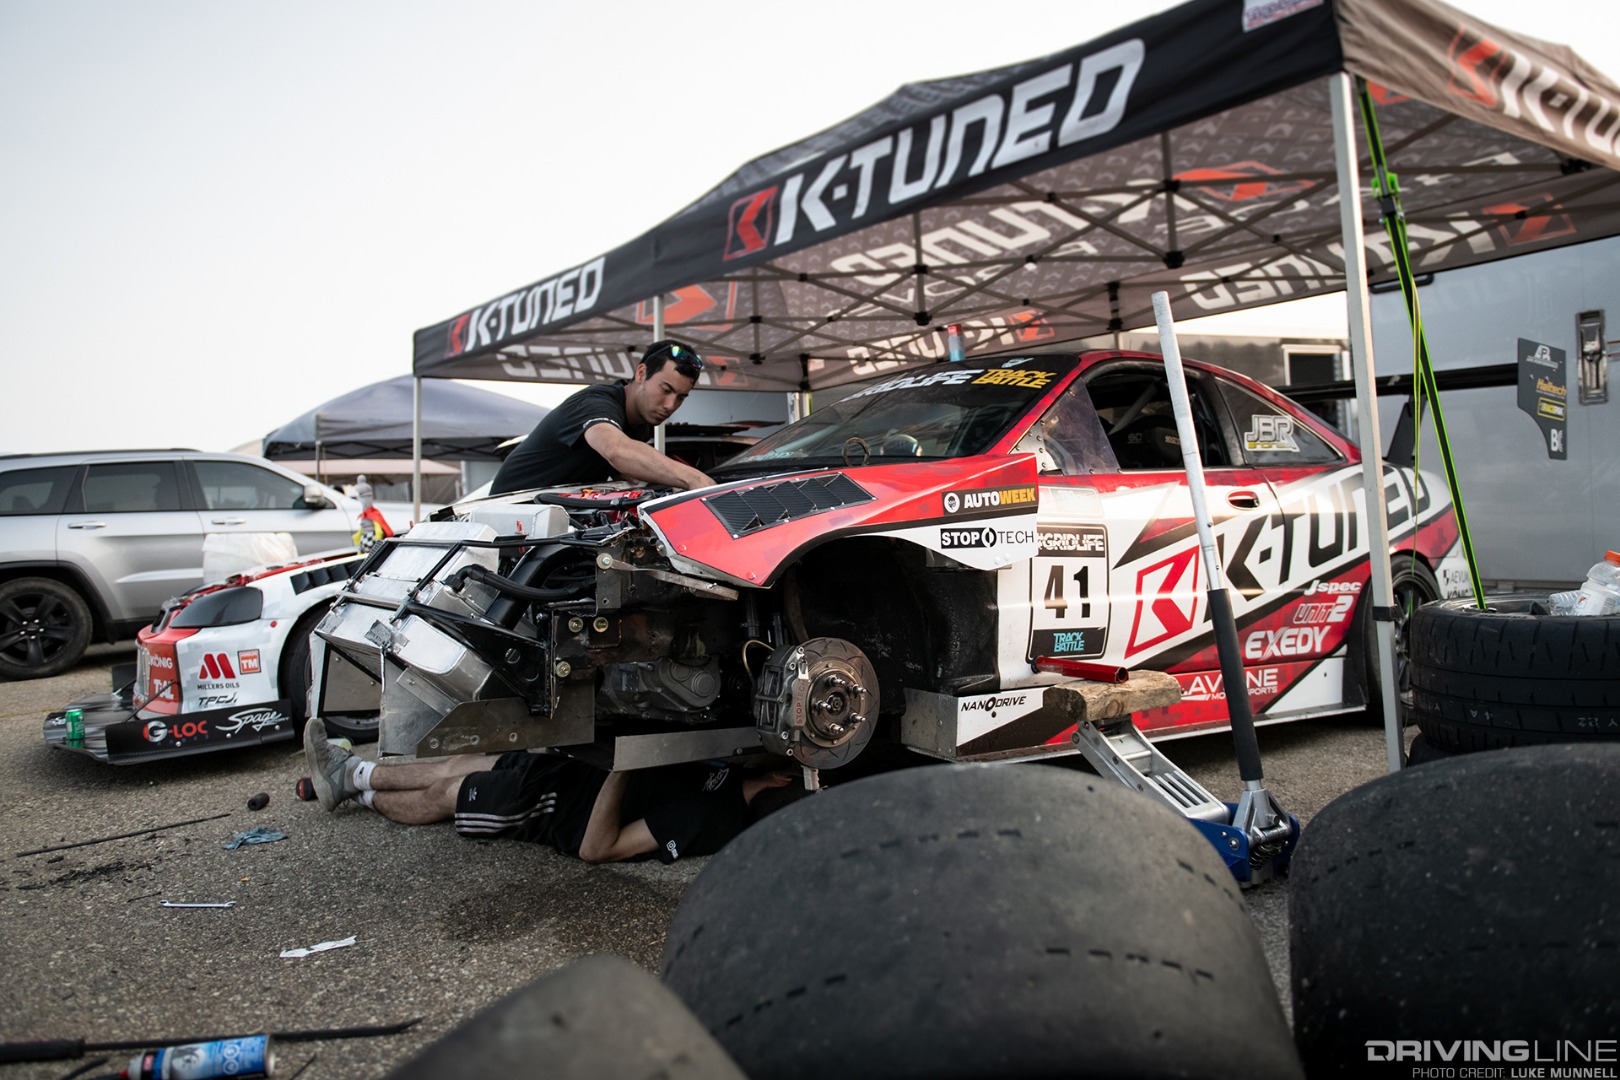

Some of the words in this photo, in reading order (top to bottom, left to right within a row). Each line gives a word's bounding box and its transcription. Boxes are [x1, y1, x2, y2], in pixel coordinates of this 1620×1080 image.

[774, 38, 1146, 246] K-TUNED
[465, 257, 605, 352] K-TUNED
[1246, 415, 1294, 442] JBR
[964, 487, 1036, 509] AUTOWEEK
[1044, 565, 1090, 618] 41
[1053, 631, 1084, 643] TRACK
[1054, 640, 1085, 653] BATTLE
[1245, 626, 1331, 660] EXEDY
[241, 659, 258, 669] TM
[961, 696, 1026, 711] NANODRIVE
[143, 720, 208, 743] G-LOC
